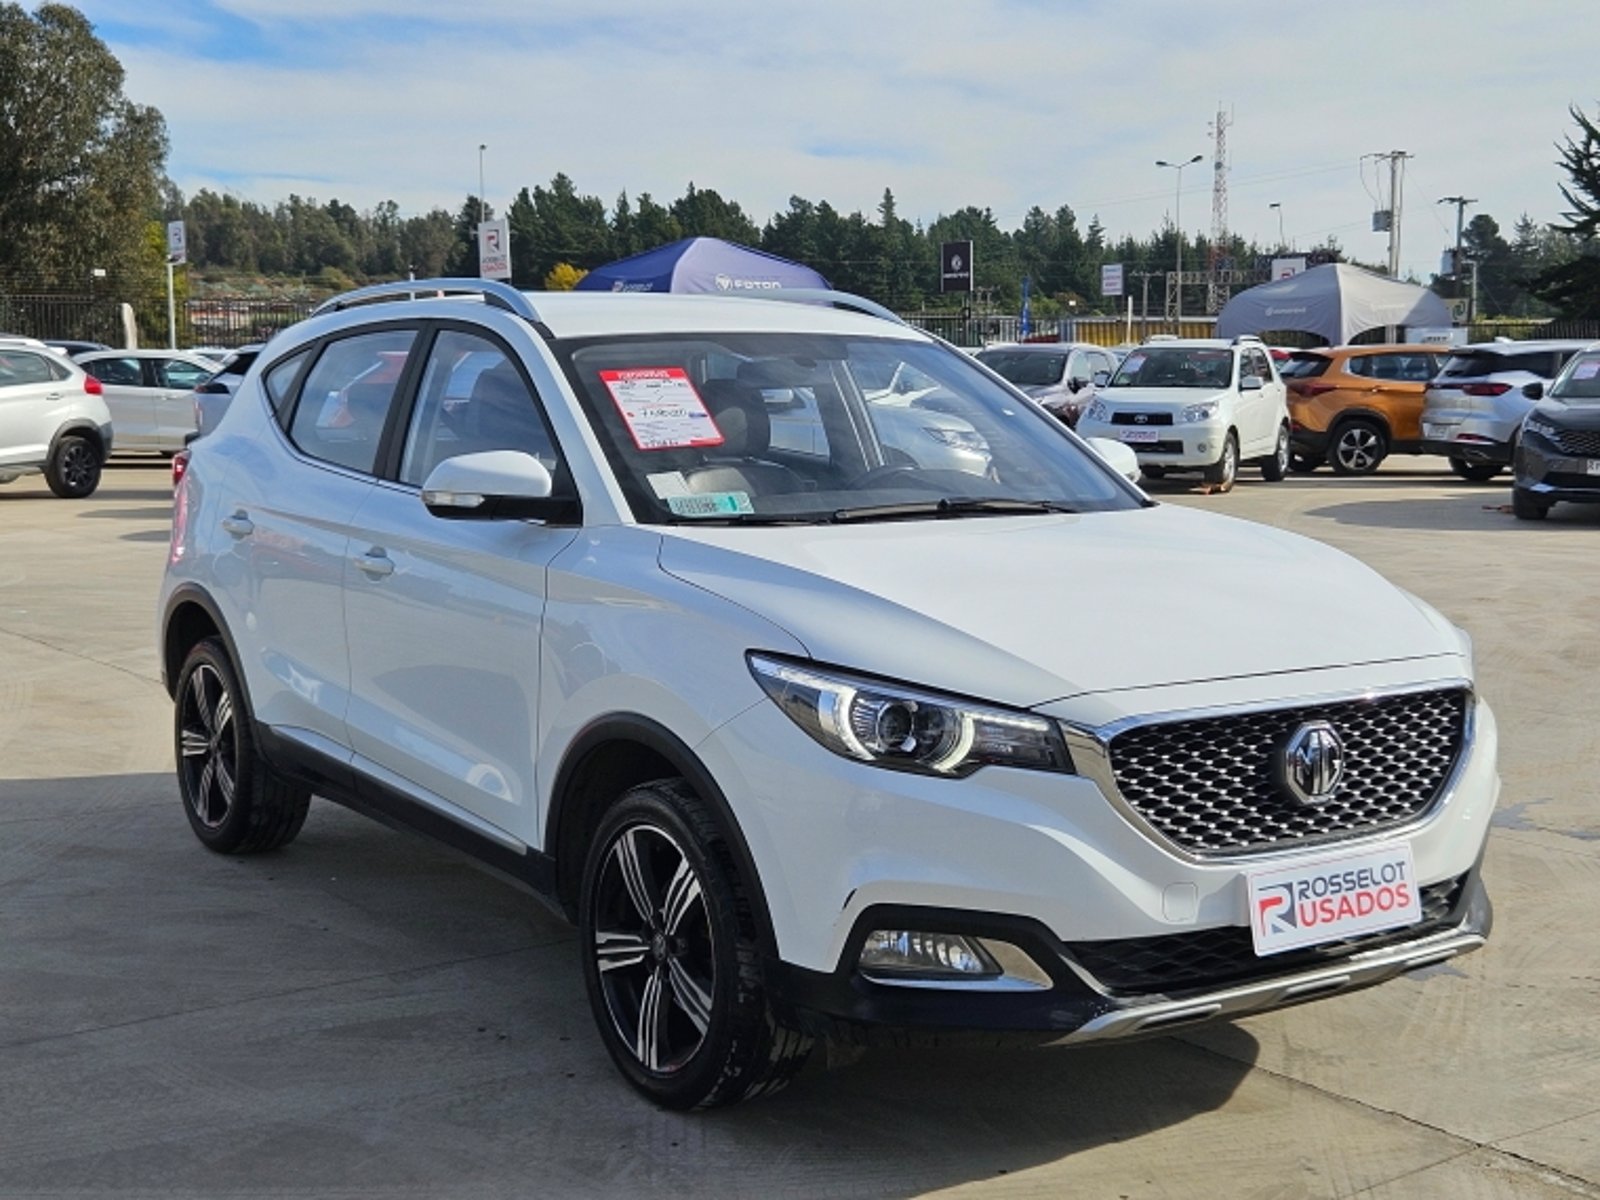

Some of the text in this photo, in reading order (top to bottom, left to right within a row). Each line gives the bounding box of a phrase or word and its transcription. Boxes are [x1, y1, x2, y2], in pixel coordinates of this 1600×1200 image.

[1295, 730, 1341, 796] MG
[1298, 861, 1406, 900] ROSSELOT
[1299, 883, 1410, 927] USADOS
